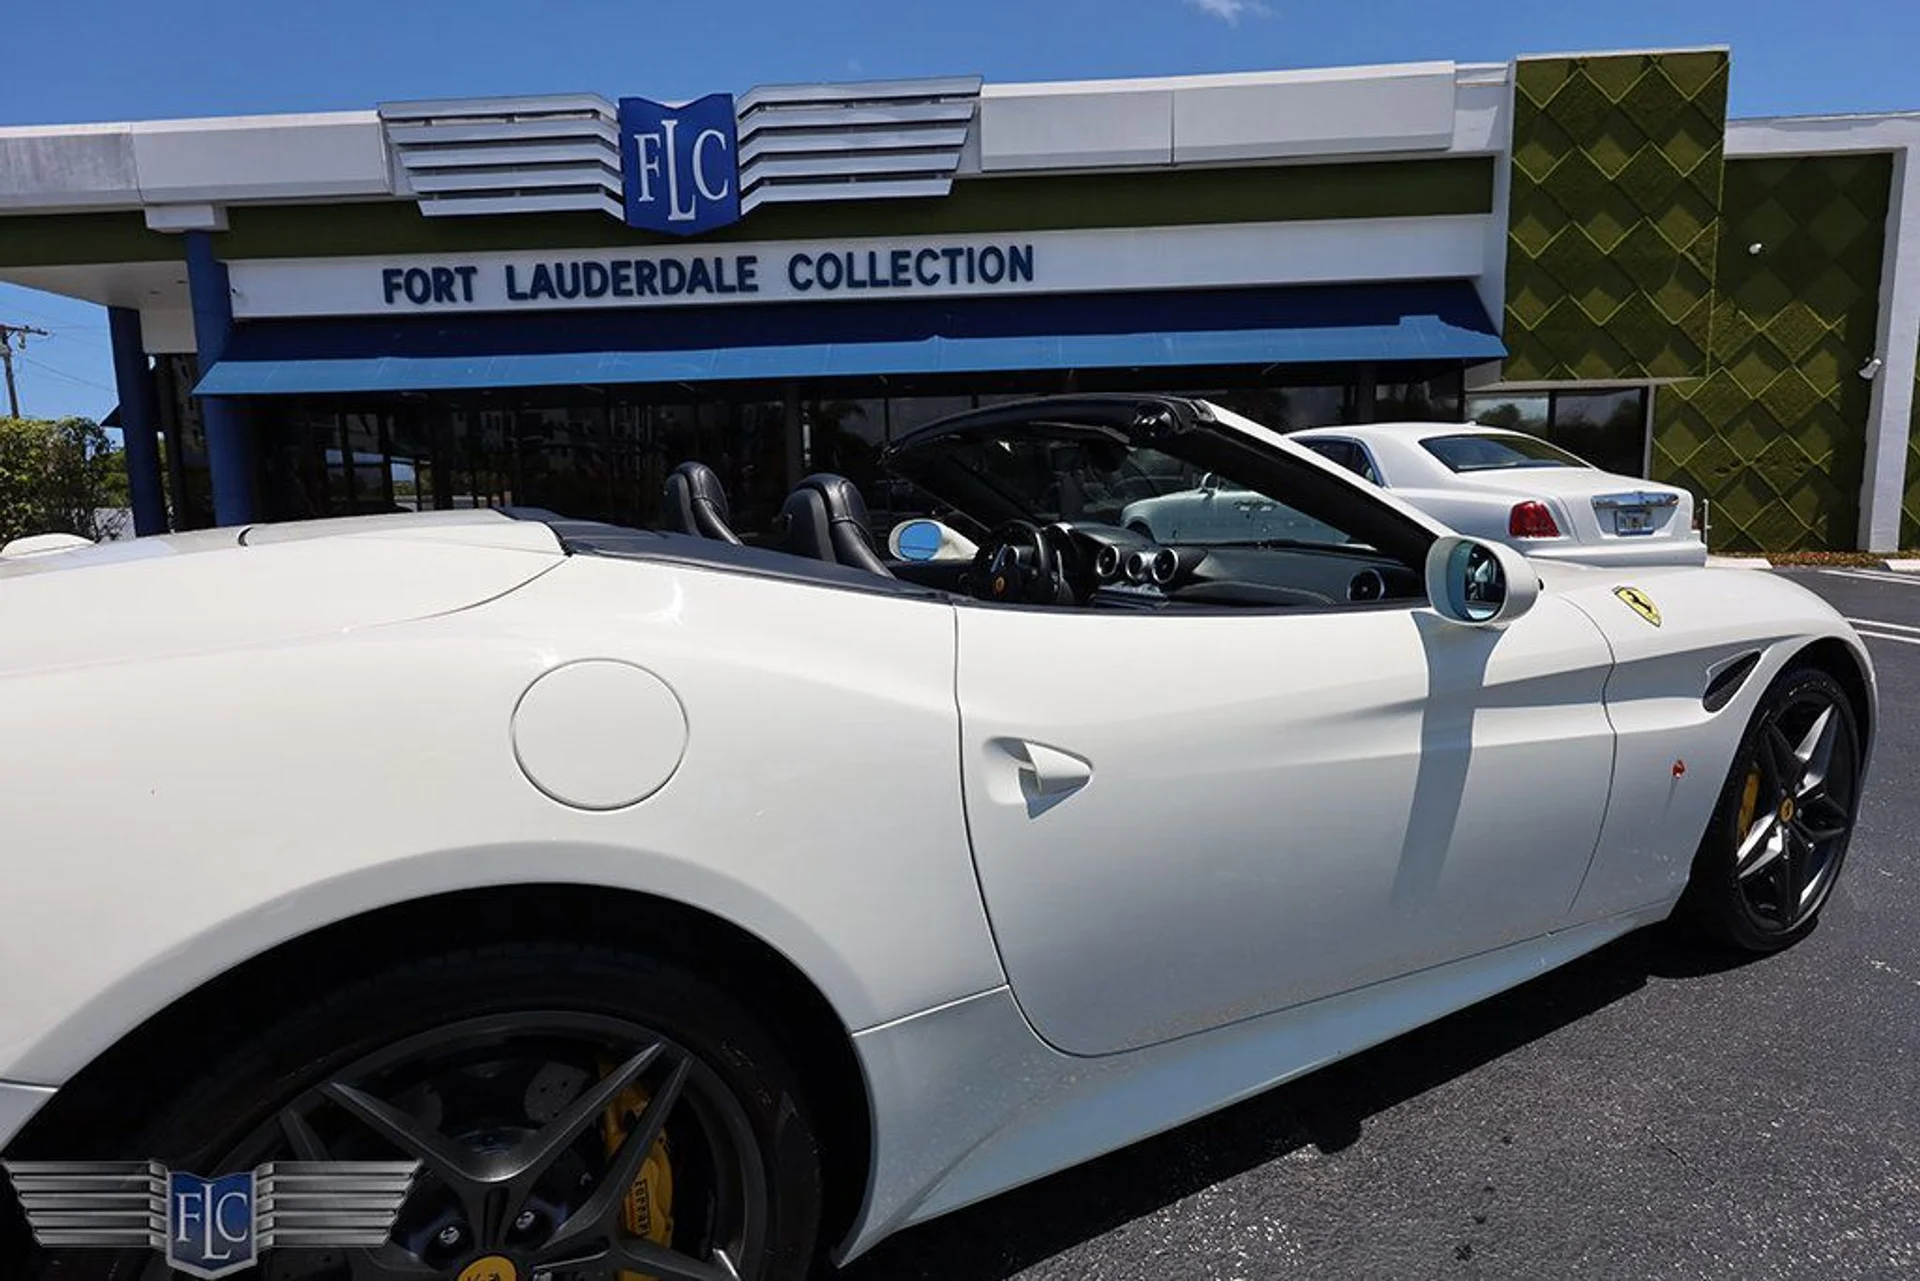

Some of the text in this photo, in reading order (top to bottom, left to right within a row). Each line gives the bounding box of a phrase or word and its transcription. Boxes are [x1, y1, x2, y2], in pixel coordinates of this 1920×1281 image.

[634, 119, 729, 221] FLC
[382, 244, 1034, 305] FORT LAUDERDALE COLLECTION
